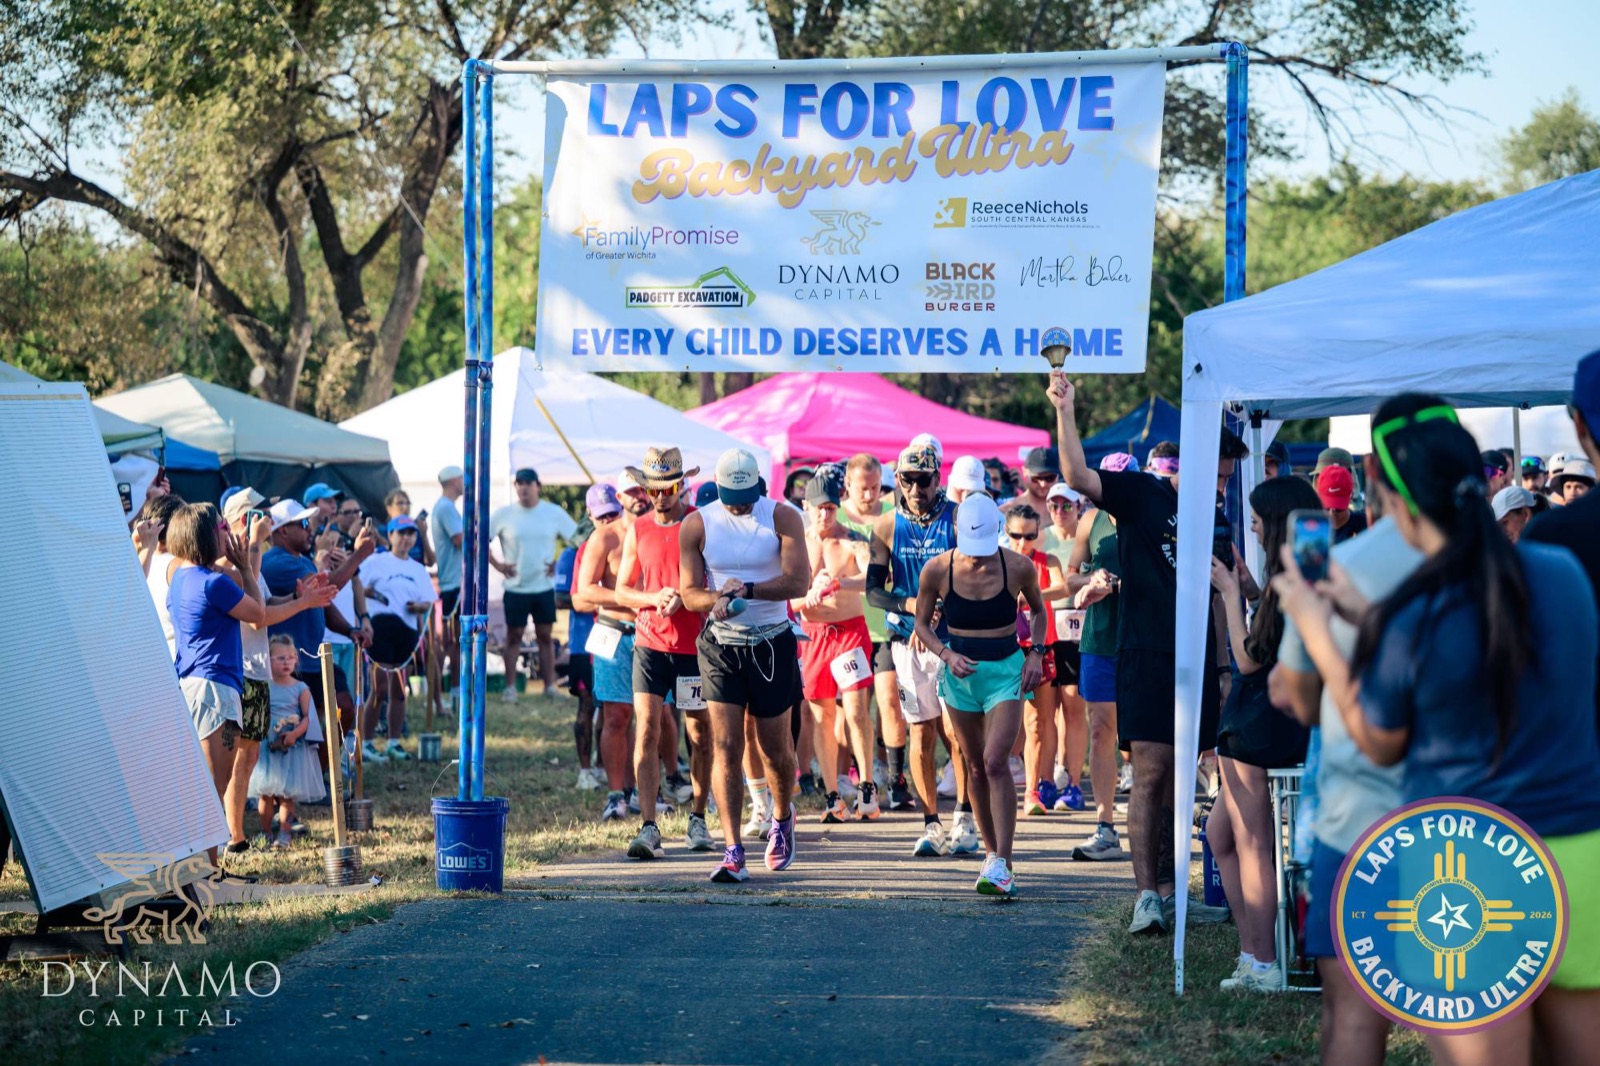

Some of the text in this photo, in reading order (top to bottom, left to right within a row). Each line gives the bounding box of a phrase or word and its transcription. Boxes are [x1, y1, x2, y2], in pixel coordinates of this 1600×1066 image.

[587, 76, 1115, 140] LAPS FOR LOVE
[631, 122, 1074, 209] Backyard Ultra
[972, 200, 1088, 214] ReeceNichols
[585, 225, 739, 250] FamilyPromise
[778, 264, 900, 284] DYNAMO
[925, 263, 996, 280] BLACK
[1020, 255, 1078, 288] Martha
[630, 292, 739, 302] PADGETT EXCAVATION
[794, 288, 882, 300] CAPITAL
[925, 302, 996, 311] BURGER
[572, 328, 674, 356] EVERY
[686, 328, 782, 356] CHILD
[794, 328, 968, 356] DESERVES
[979, 328, 1003, 356] A
[1069, 618, 1080, 629] 79
[843, 660, 858, 674] 96
[440, 853, 486, 868] LOWE'S
